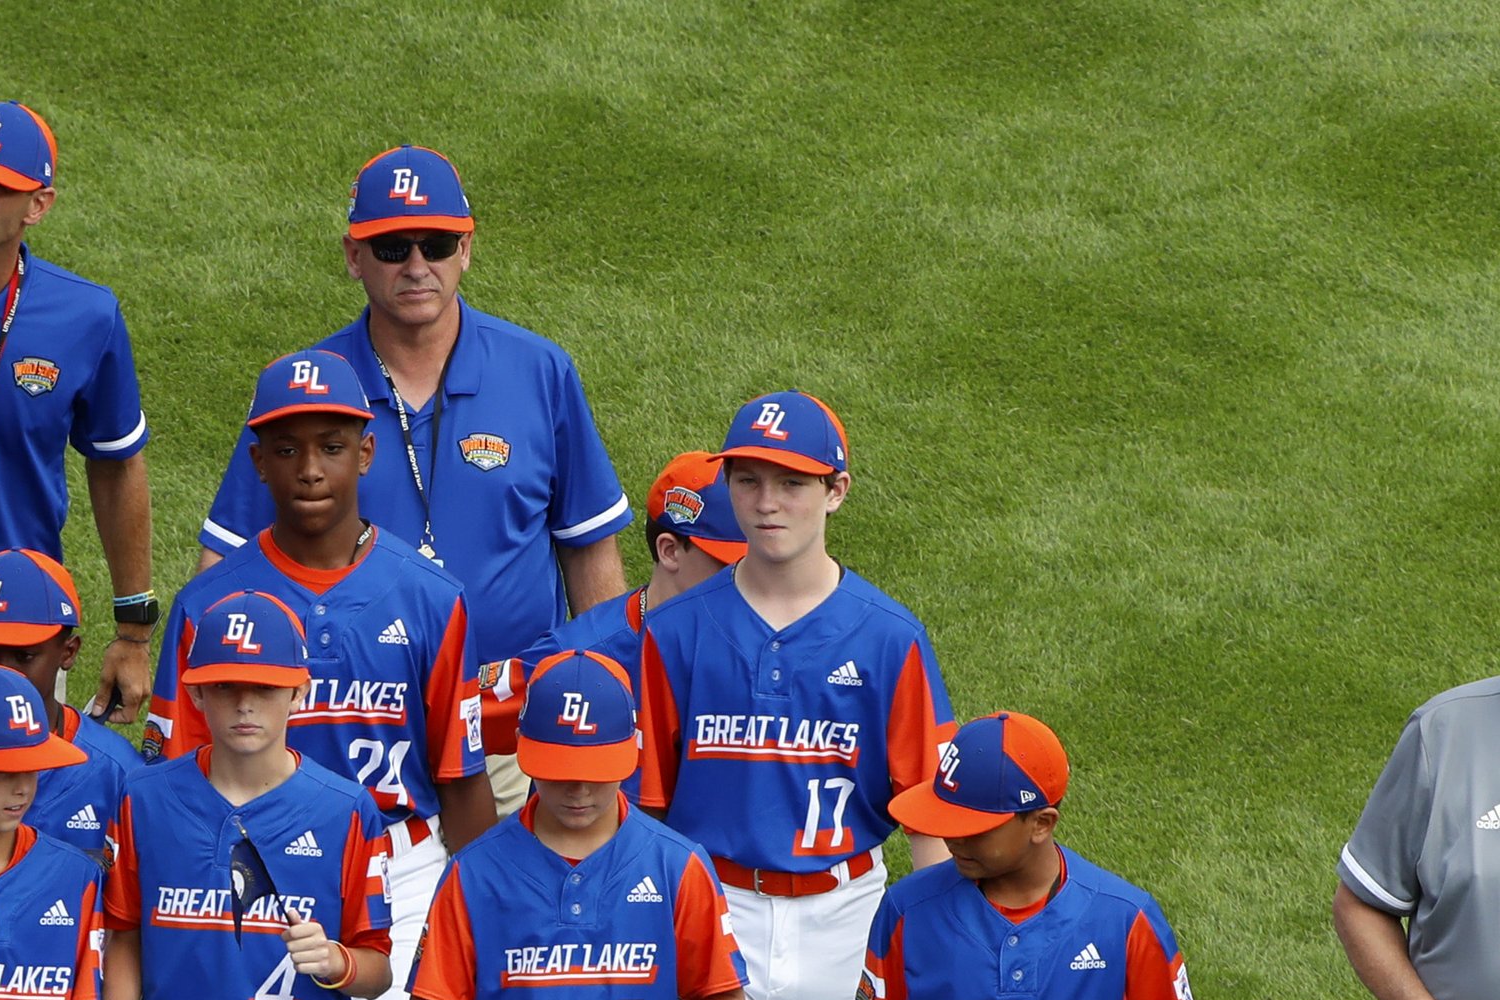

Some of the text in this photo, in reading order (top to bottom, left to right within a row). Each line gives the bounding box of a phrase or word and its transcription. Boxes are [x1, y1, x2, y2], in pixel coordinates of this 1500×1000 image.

[389, 168, 428, 205] GL
[289, 360, 328, 394] GL
[752, 403, 788, 440] GL
[222, 614, 262, 654] GL
[378, 634, 409, 645] adida
[329, 679, 407, 713] LAKES
[827, 674, 863, 686] adidas
[6, 695, 41, 735] GL
[557, 693, 597, 734] GL
[695, 714, 859, 754] GREAT LAKES
[348, 738, 411, 806] 24
[938, 743, 960, 792] GL
[66, 820, 100, 830] adidas
[801, 777, 855, 848] 17
[285, 845, 322, 857] adidas
[158, 886, 315, 928] GREAT AKES
[627, 893, 663, 903] adidas
[40, 916, 74, 926] adidas
[504, 942, 657, 975] GREAT LAKES
[1070, 959, 1106, 971] adidas
